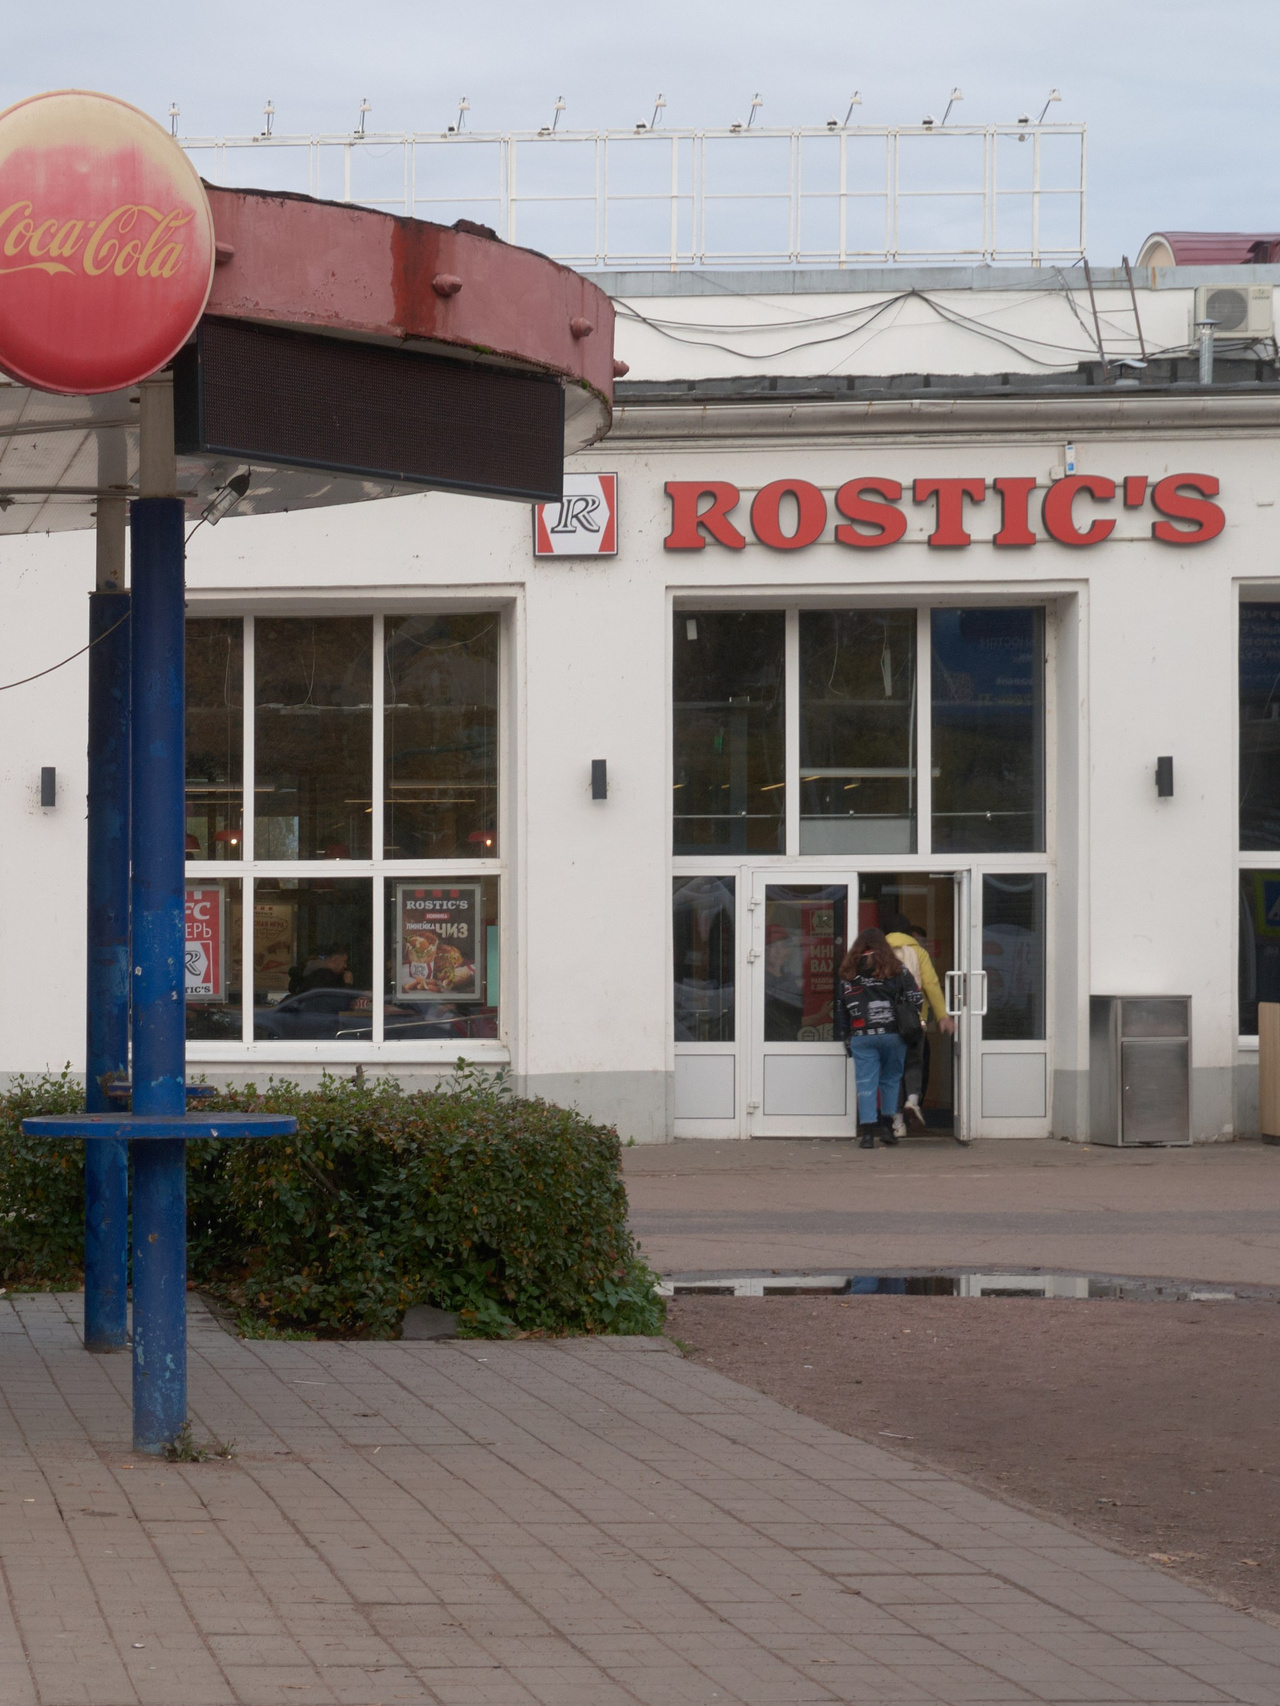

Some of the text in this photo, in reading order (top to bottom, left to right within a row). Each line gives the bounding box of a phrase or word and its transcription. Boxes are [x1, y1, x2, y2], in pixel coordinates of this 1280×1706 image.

[663, 472, 1227, 552] ROSTIC'S
[406, 900, 469, 910] ROSTIC'S
[185, 922, 212, 938] ЕРЬ
[435, 922, 469, 938] ЧИЗ
